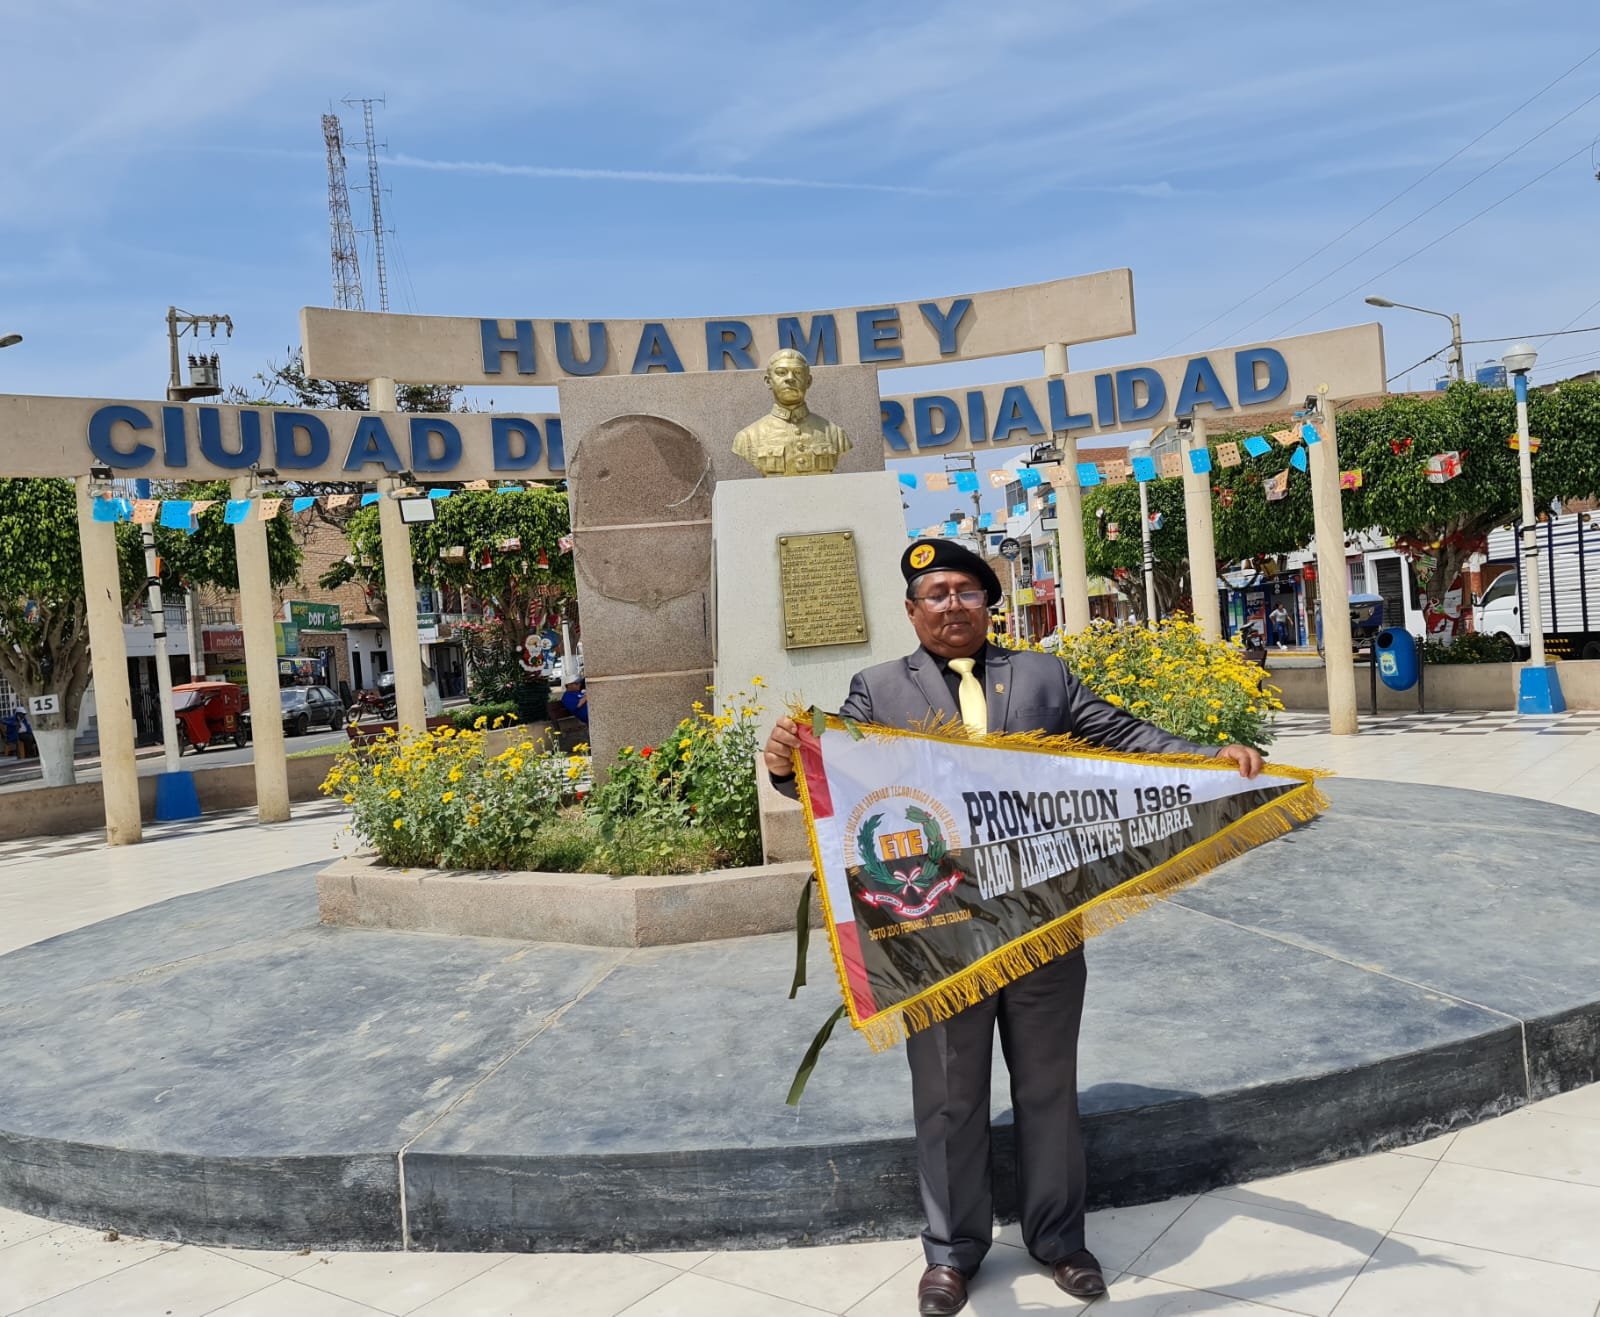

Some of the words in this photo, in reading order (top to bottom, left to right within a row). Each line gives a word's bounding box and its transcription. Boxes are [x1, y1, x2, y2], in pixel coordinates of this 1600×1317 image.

[480, 299, 972, 376] HUARMEY
[87, 405, 463, 473] CIUDAD
[34, 698, 53, 711] 15
[879, 828, 923, 862] ETE
[962, 789, 1120, 846] PROMOCION
[1133, 784, 1192, 815] 1986
[974, 846, 1015, 900] CABO
[1017, 830, 1079, 888] ALBERTO
[1076, 822, 1124, 865] REYES
[1128, 807, 1193, 848] GAMARRA
